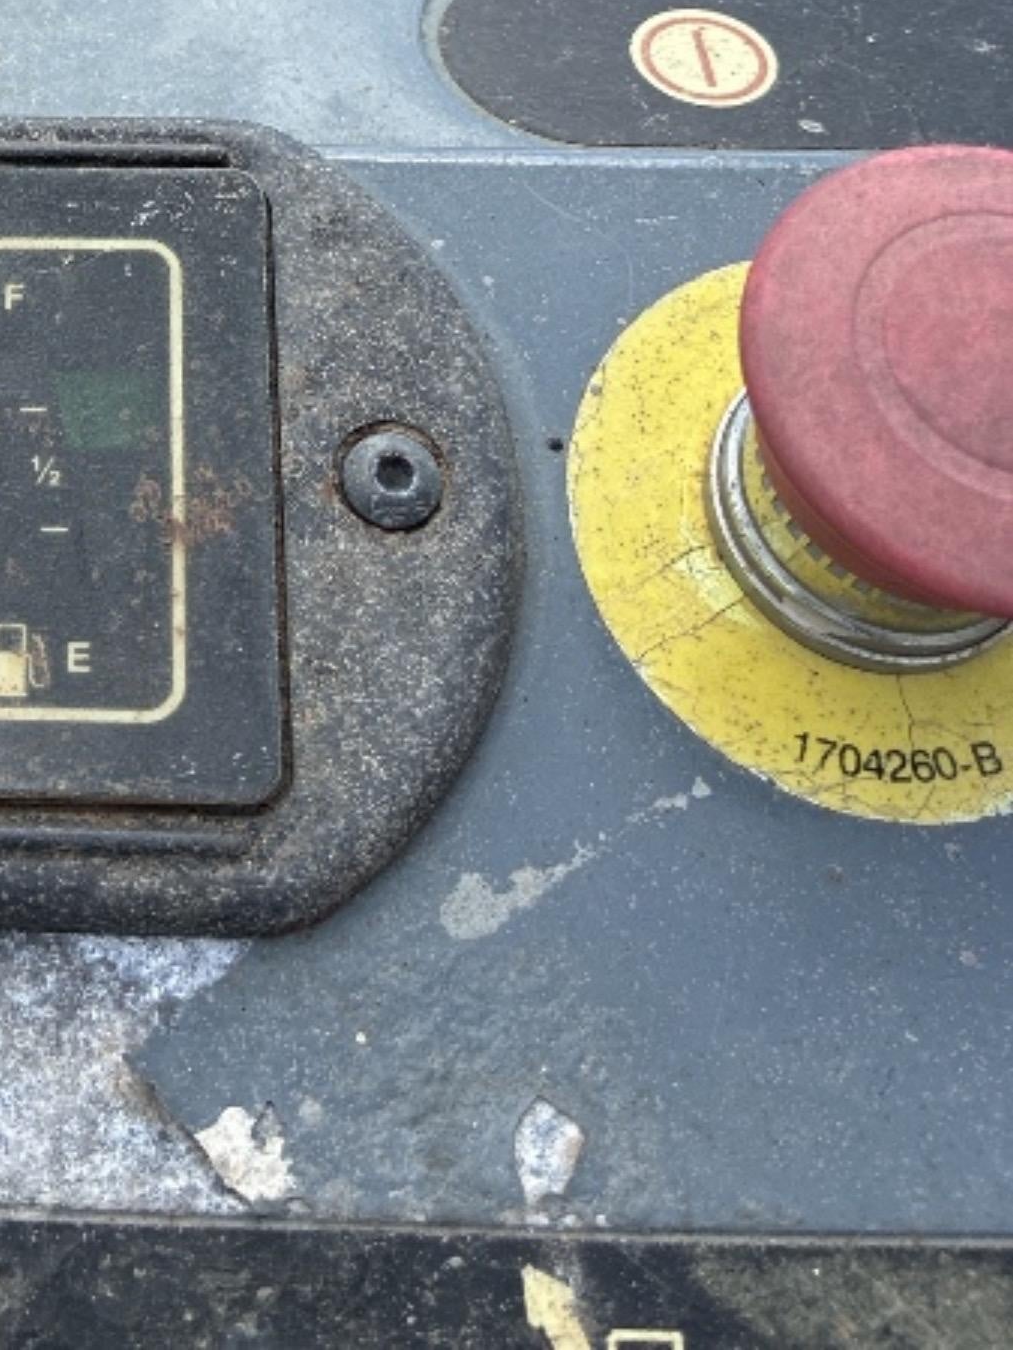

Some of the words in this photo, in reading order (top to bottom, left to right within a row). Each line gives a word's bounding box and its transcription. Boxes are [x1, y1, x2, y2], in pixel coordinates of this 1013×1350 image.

[4, 284, 25, 310] F
[68, 641, 91, 672] E
[793, 731, 1003, 783] 1704260-B
